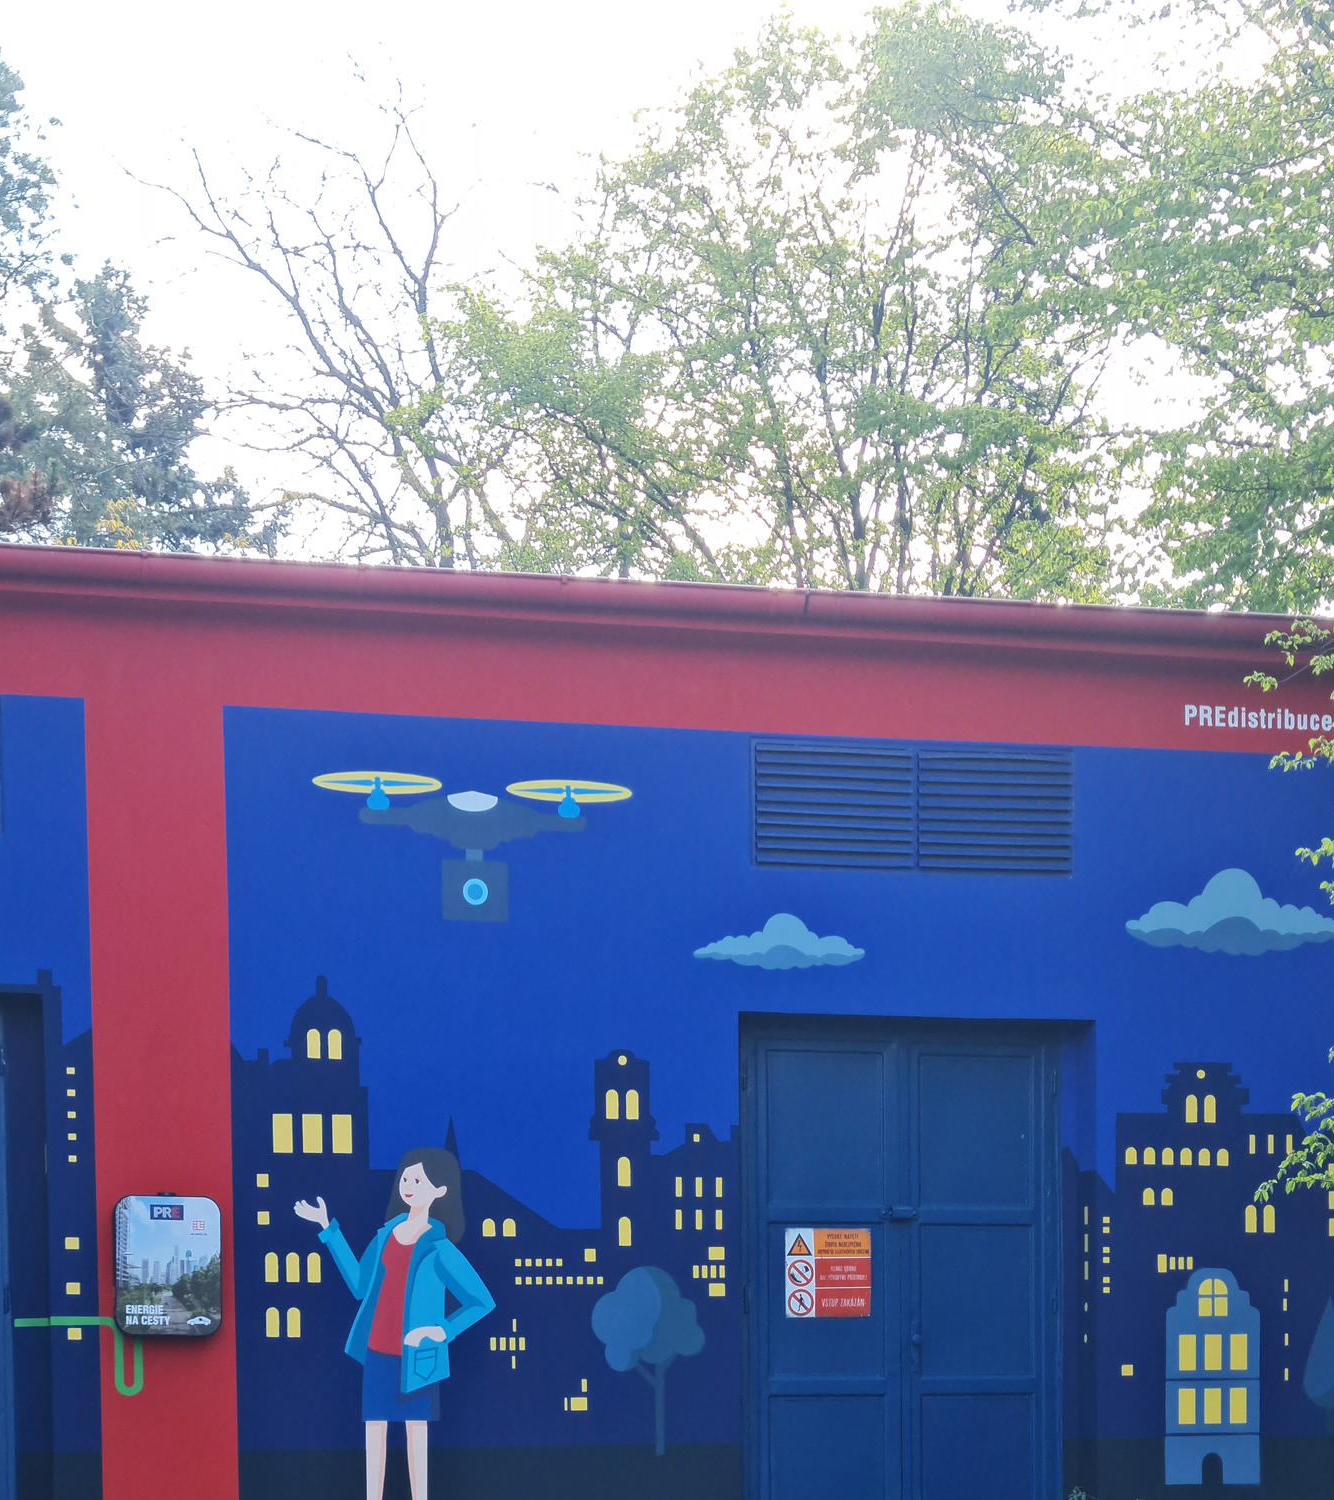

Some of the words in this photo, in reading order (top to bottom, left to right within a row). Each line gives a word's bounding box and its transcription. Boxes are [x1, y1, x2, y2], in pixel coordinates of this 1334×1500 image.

[153, 1206, 180, 1219] PRE
[821, 1298, 838, 1307] VSTUP
[125, 1304, 164, 1315] ENERGIE
[125, 1316, 138, 1325] NA
[141, 1315, 171, 1325] CESTY
